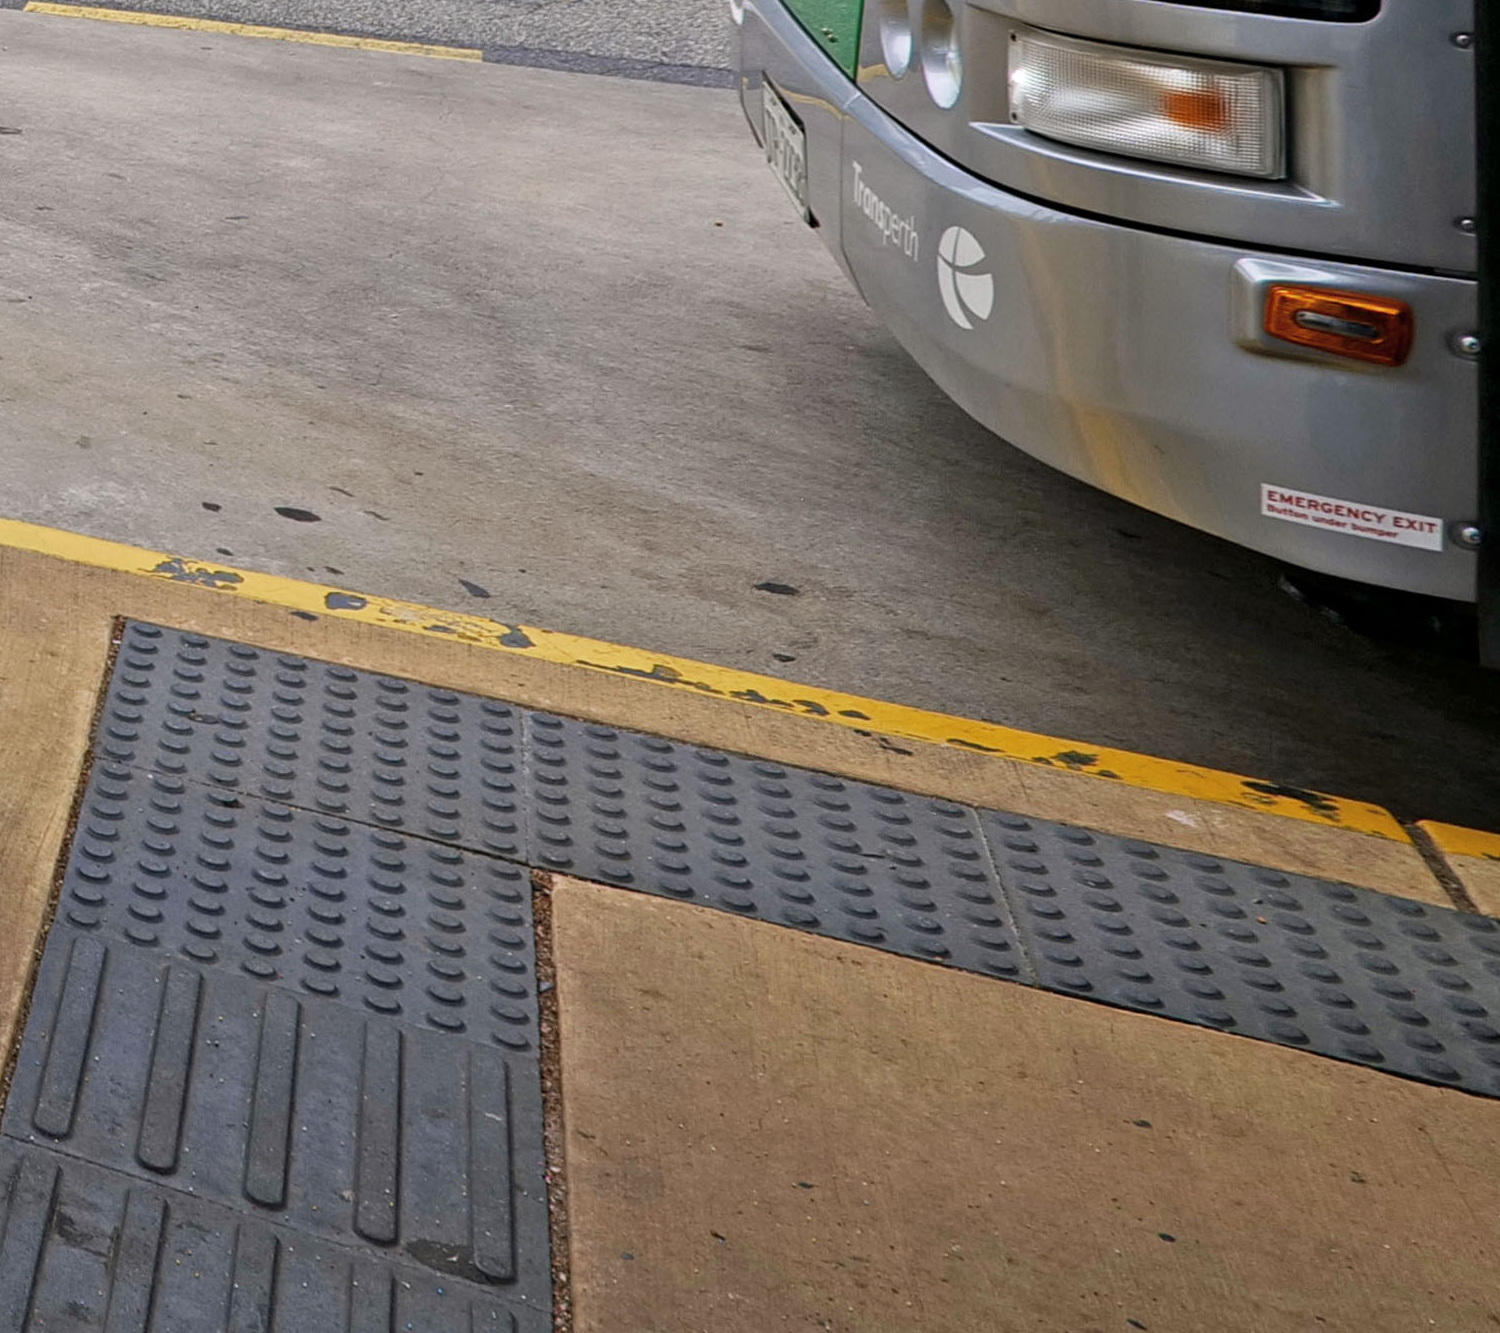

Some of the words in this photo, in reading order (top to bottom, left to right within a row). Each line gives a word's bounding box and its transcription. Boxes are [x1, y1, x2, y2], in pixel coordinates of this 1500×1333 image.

[852, 160, 919, 261] Transperth
[1267, 491, 1387, 524] EMERGENCY
[1393, 517, 1437, 533] EXIT
[1267, 504, 1309, 520] Button
[1312, 516, 1348, 528] under
[1351, 523, 1398, 539] bumper
